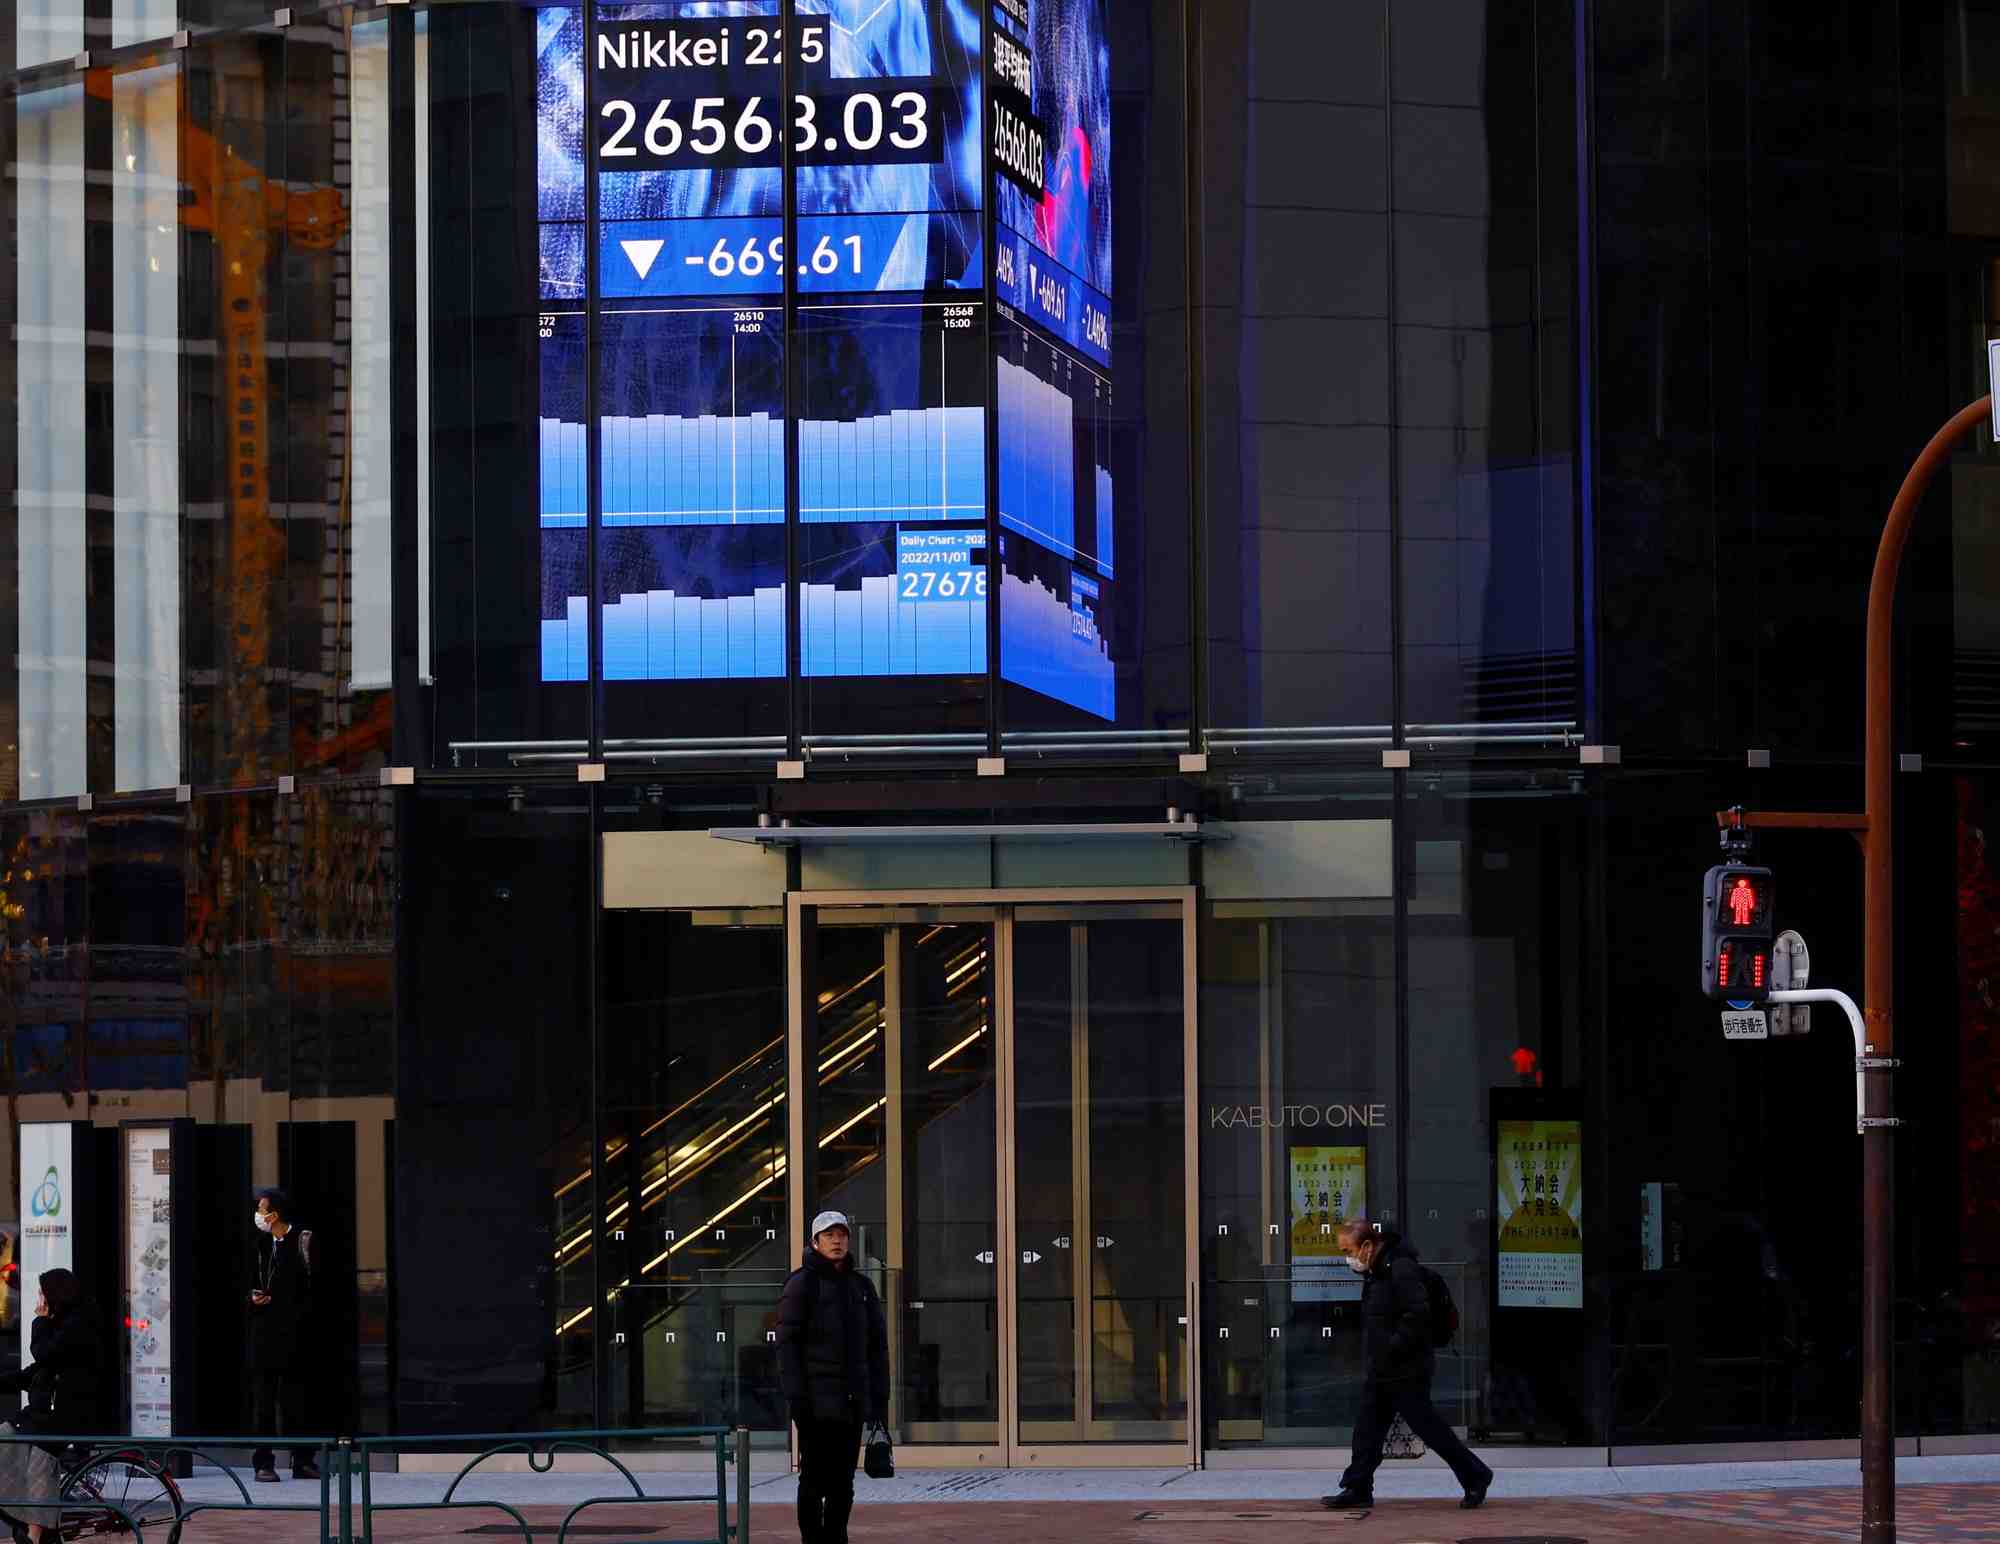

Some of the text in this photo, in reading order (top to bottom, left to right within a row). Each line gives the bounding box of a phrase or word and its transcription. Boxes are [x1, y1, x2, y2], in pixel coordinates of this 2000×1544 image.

[598, 27, 824, 70] Nikkei 25
[600, 92, 928, 157] 26568.03
[994, 99, 1042, 189] 26568.03
[685, 235, 863, 277] -669.61
[1039, 275, 1065, 322] -669.61
[733, 311, 764, 322] 26510
[943, 306, 974, 317] 26568
[943, 318, 971, 328] 15:00
[734, 323, 761, 333] 14:00
[1082, 303, 1107, 350] -2.46%
[901, 535, 926, 547] Daily
[927, 535, 955, 546] Chart
[901, 550, 967, 565] 2022/11/01
[902, 571, 986, 597] 27678
[1210, 1104, 1386, 1128] KABUTO ONE
